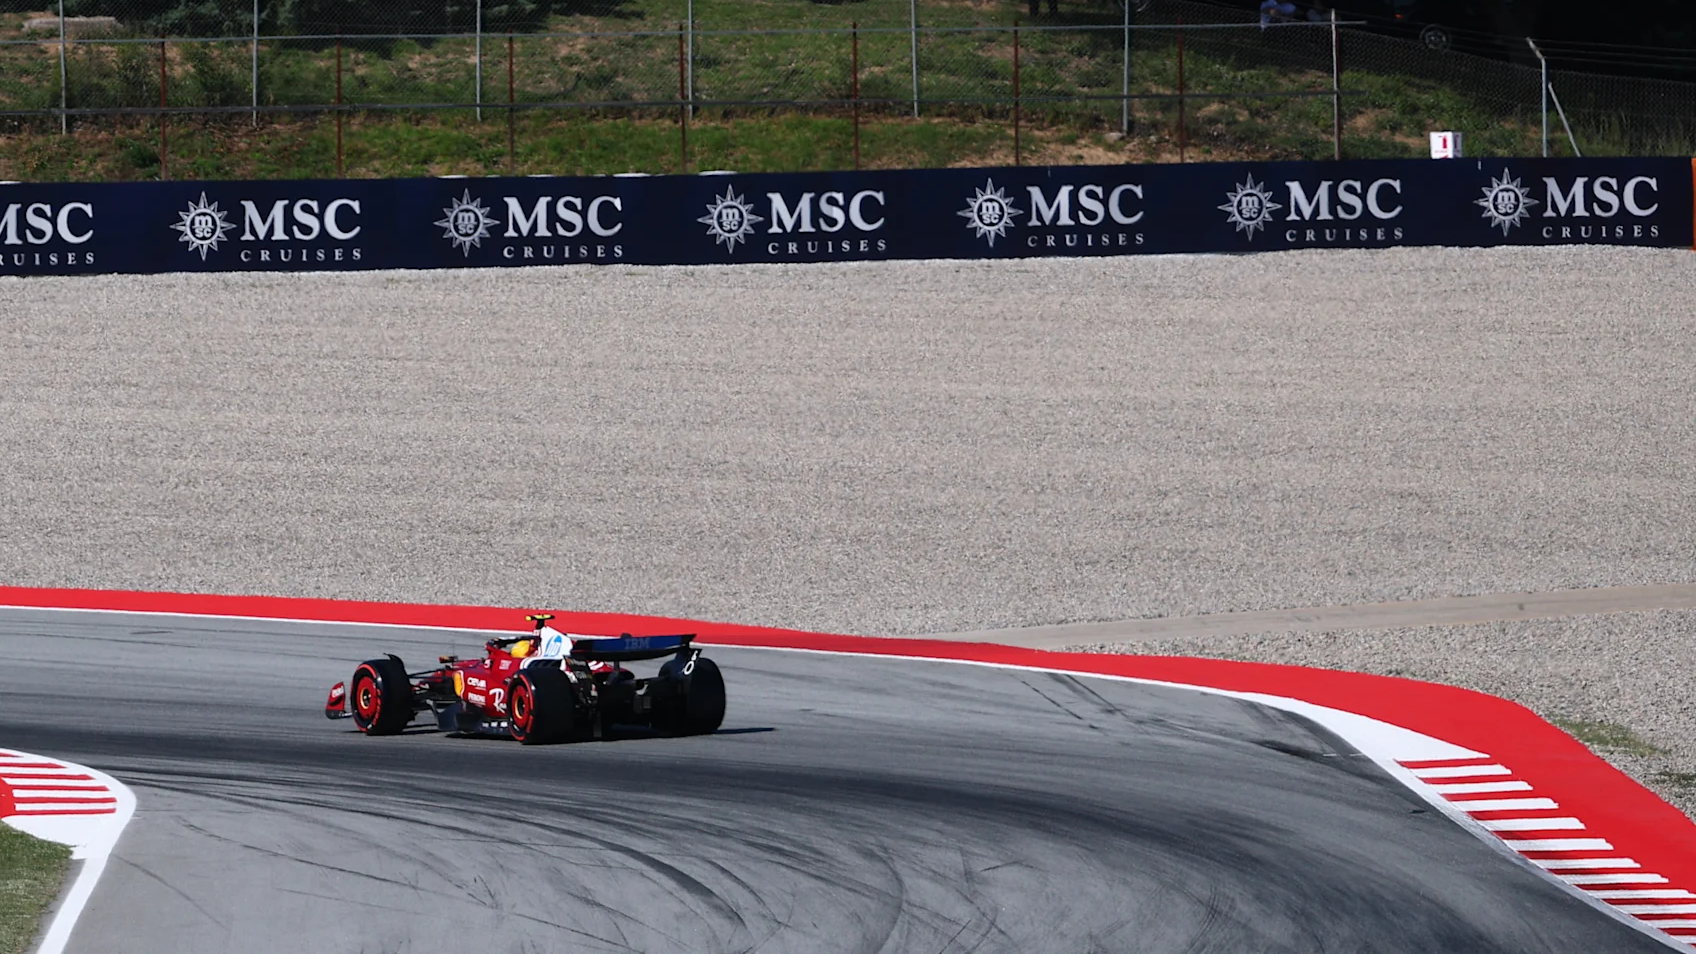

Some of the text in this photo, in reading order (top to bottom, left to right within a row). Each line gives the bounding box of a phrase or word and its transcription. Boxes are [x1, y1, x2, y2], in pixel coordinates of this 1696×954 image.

[1284, 178, 1403, 221] MSC
[1542, 175, 1659, 218] MSC
[766, 189, 885, 234] MSC
[1026, 183, 1144, 227] MSC
[239, 198, 361, 241] MSC
[503, 195, 623, 238] MSC
[1285, 228, 1403, 242] CRUISES
[1542, 224, 1659, 238] CRUISES
[767, 239, 886, 255] CRUISES
[1027, 233, 1144, 247] CRUISES
[240, 248, 361, 262] CRUISES
[502, 244, 623, 259] CRUISES
[624, 638, 650, 649] IBM
